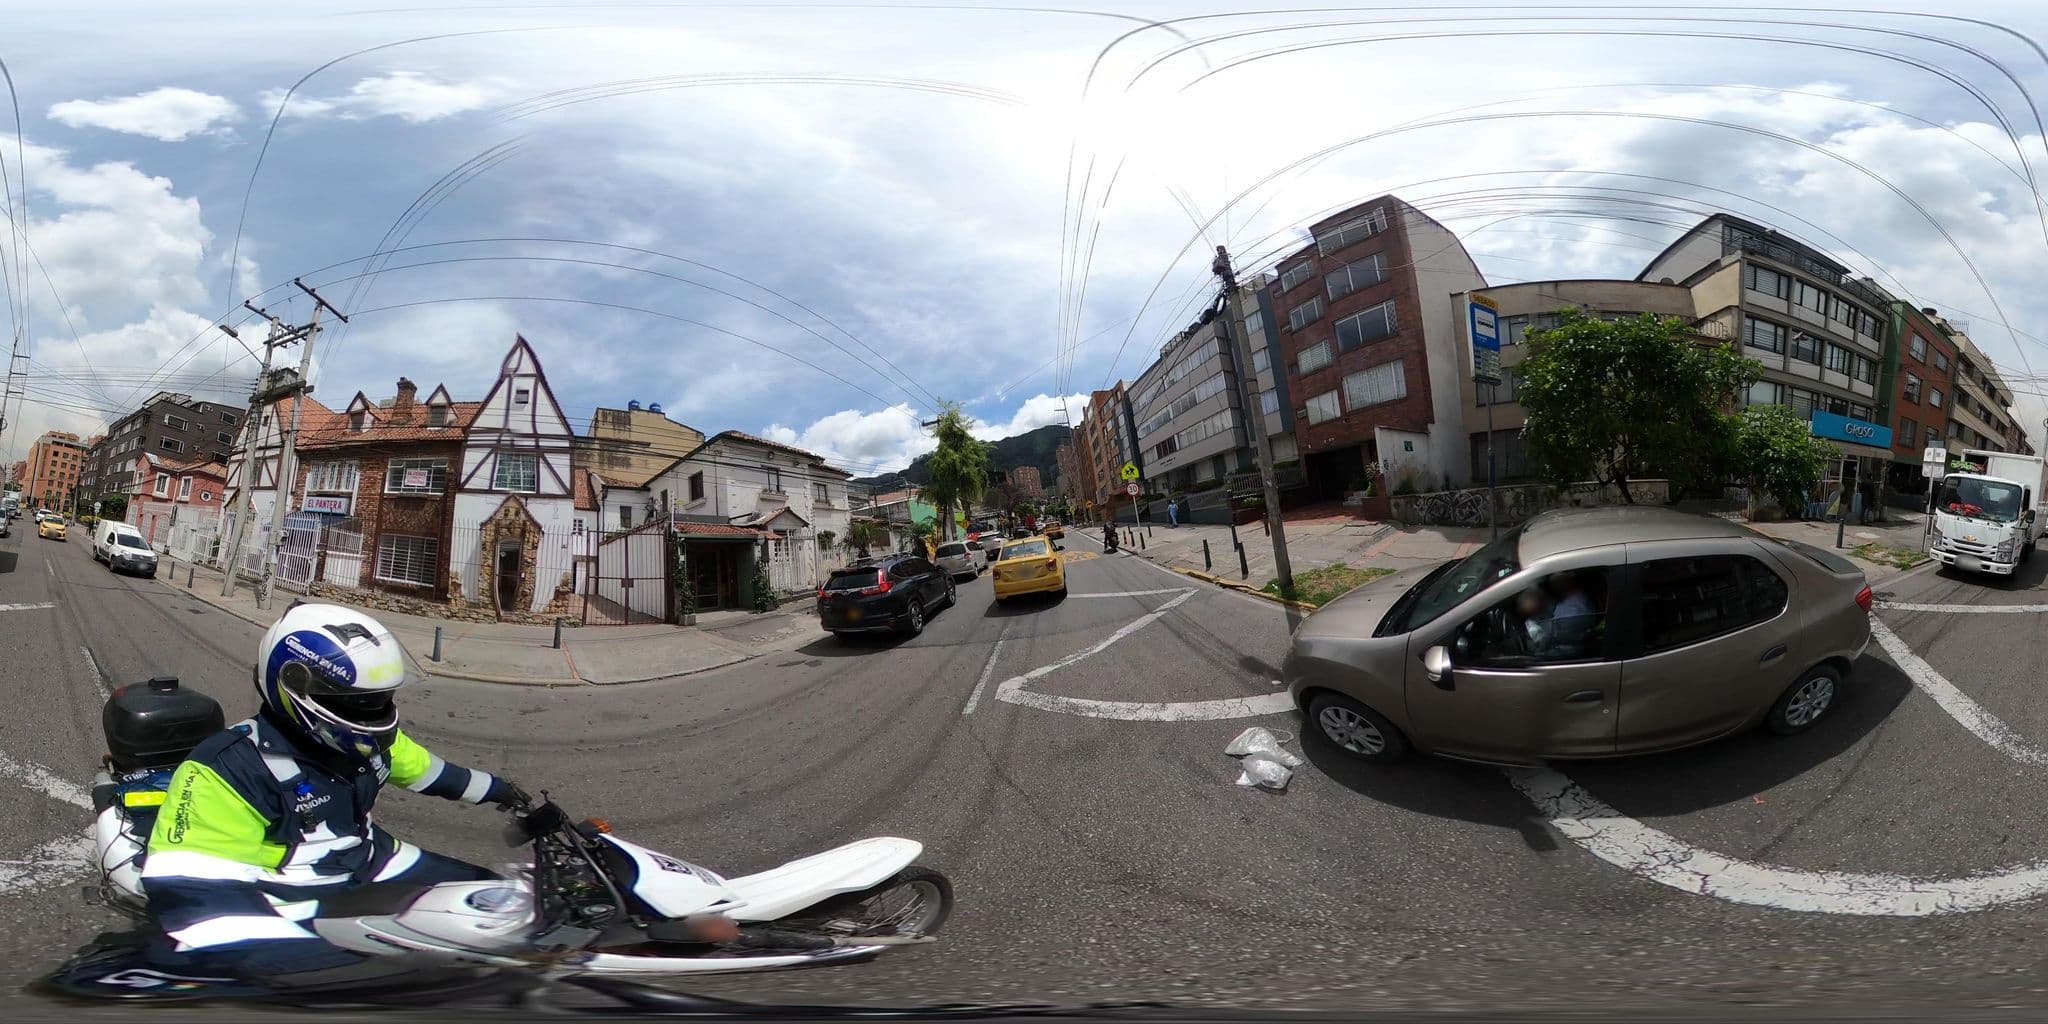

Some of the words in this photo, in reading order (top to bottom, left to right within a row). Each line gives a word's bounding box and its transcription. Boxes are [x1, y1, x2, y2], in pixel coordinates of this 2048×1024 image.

[1845, 422, 1874, 437] GROSO
[1128, 485, 1138, 493] 30
[307, 499, 314, 508] EL
[315, 500, 342, 509] PANTERA
[284, 635, 320, 663] GERENCIA
[167, 801, 187, 844] GERENCIA
[181, 789, 192, 801] EN
